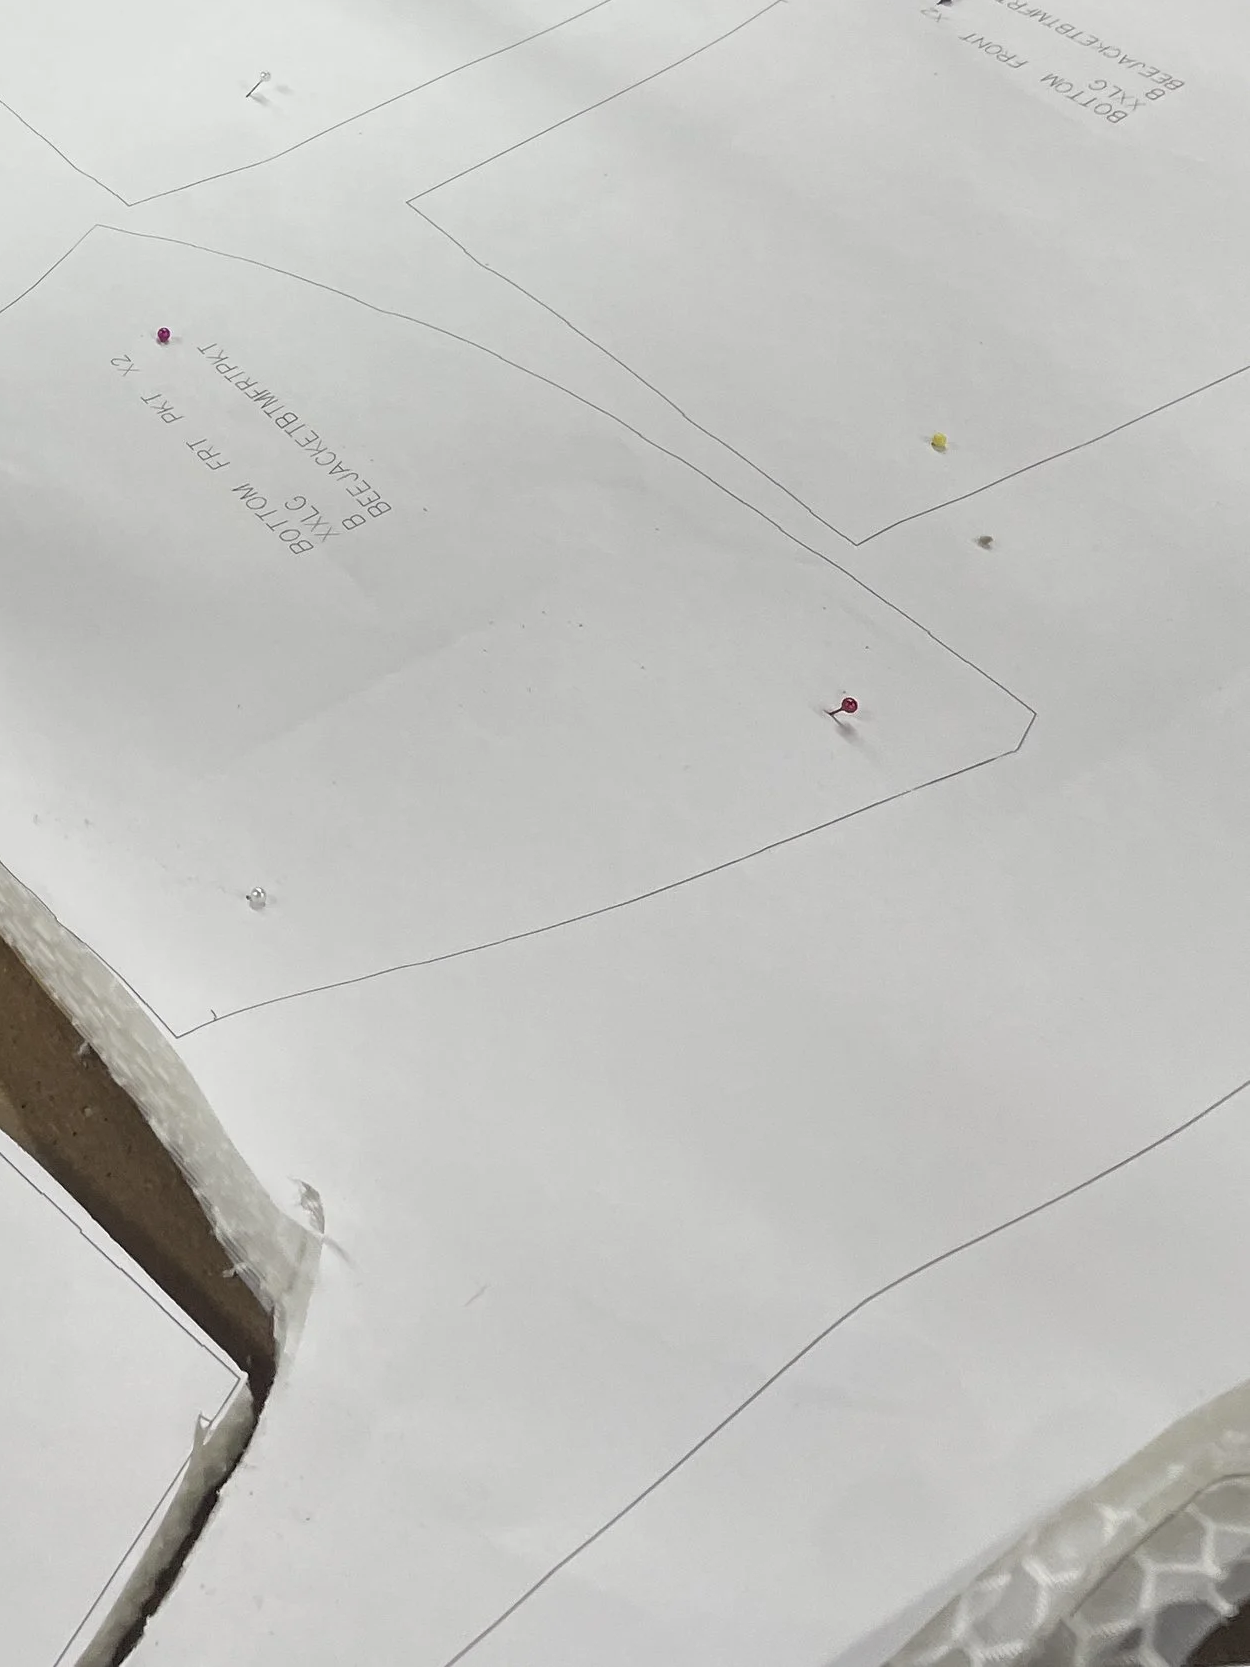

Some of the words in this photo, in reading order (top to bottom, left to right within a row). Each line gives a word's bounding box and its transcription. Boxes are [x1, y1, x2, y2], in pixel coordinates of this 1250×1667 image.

[958, 32, 1028, 69] FRONT
[1040, 73, 1128, 124] BOTTOM
[1088, 79, 1146, 111] XXLG
[1145, 88, 1165, 101] B
[110, 354, 140, 377] X2
[140, 393, 185, 424] PKT
[197, 342, 392, 518] BEEJACKETBTMFRTPKT
[186, 439, 230, 471] FRT
[231, 483, 314, 555] BOTTOM
[284, 495, 343, 543] XXLG
[342, 514, 366, 530] B
